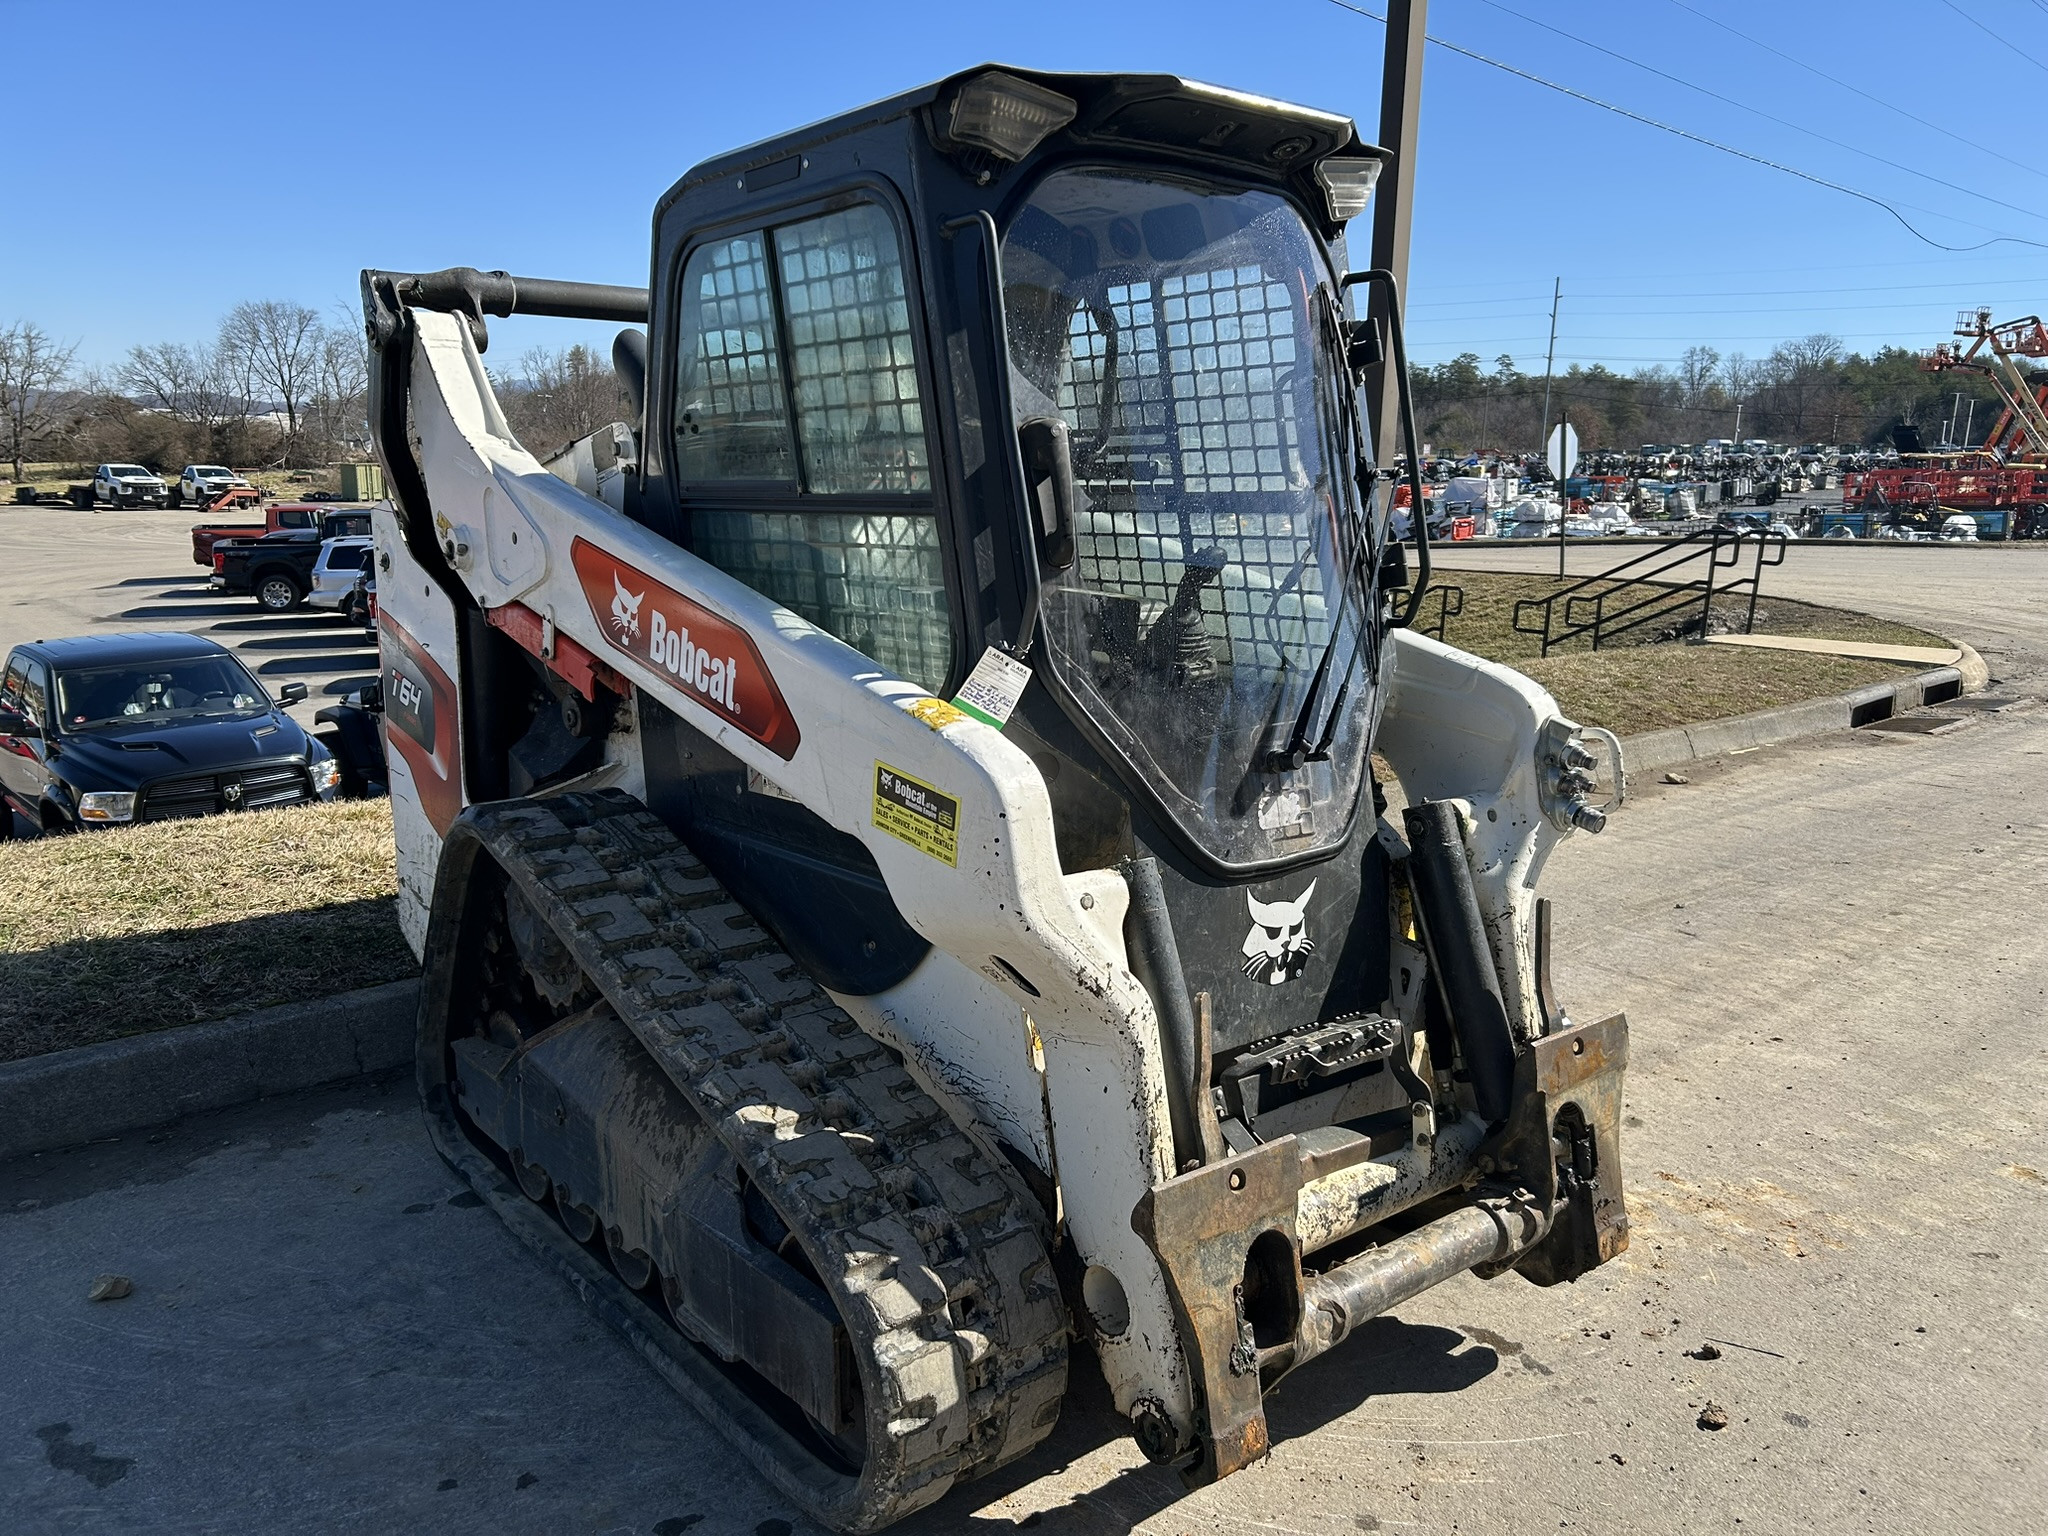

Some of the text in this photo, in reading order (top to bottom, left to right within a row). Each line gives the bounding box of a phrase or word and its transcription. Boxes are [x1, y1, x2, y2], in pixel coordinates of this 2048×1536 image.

[650, 609, 736, 712] Bobcat
[391, 668, 422, 715] T64
[895, 779, 926, 806] Bobcat
[876, 807, 953, 851] SALES SERVICE PARTS RENTALS
